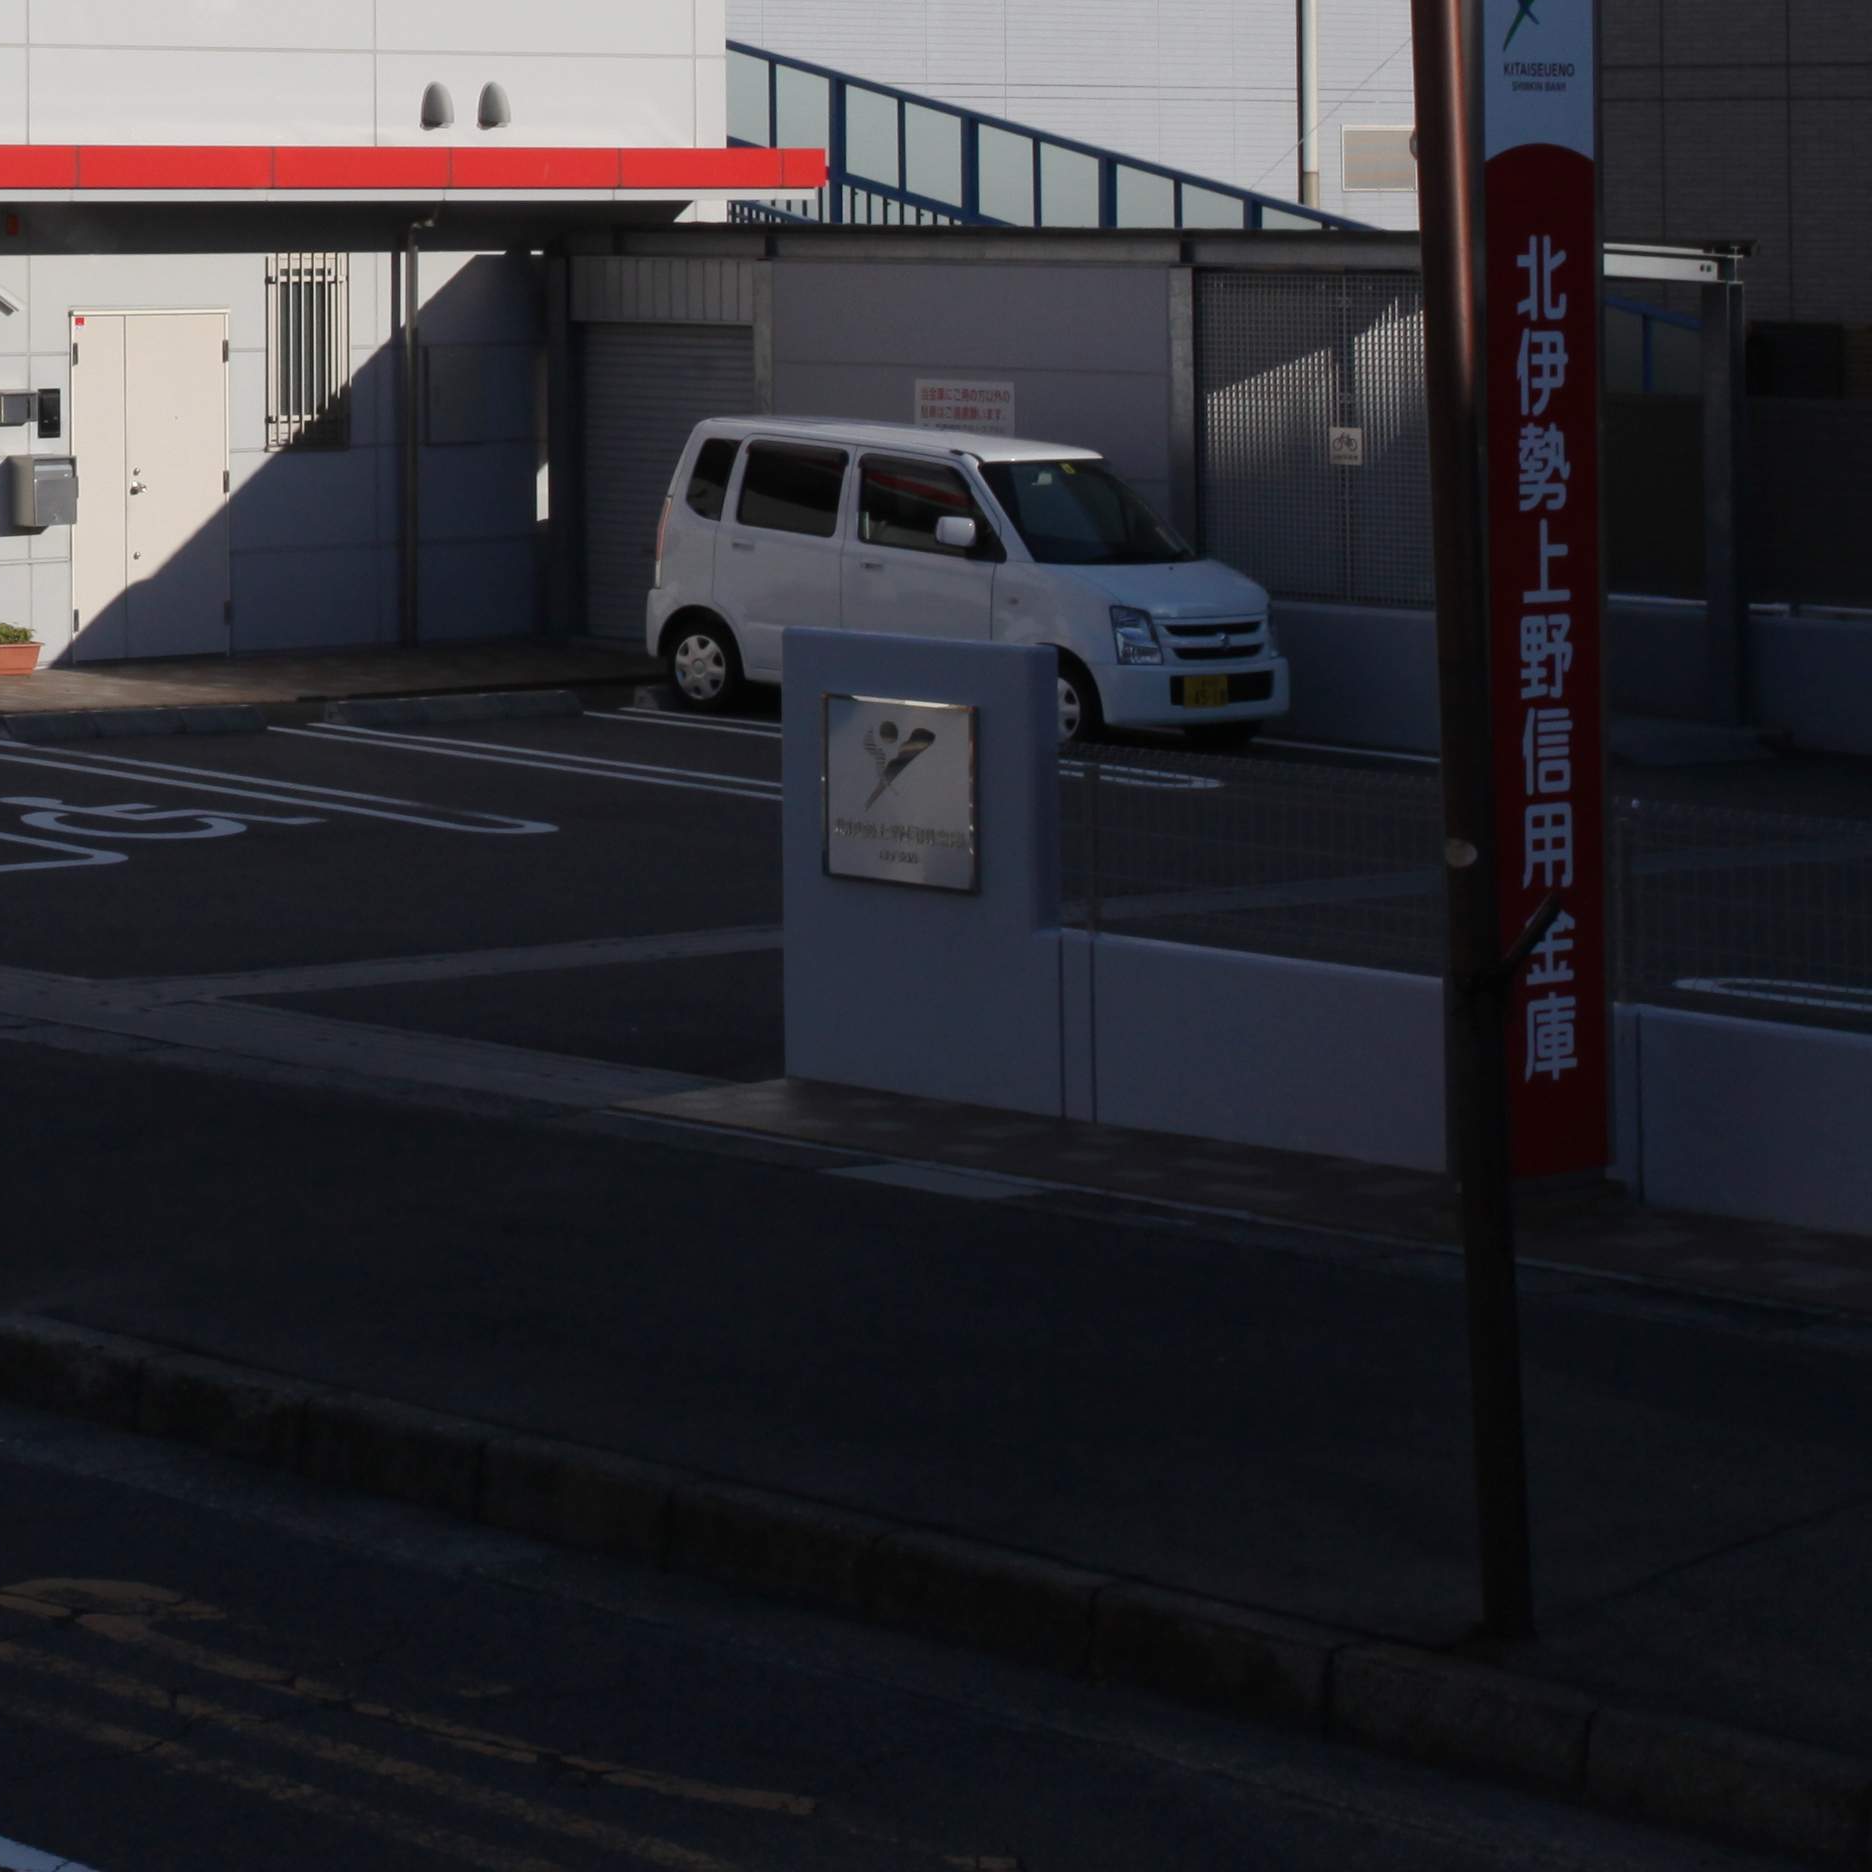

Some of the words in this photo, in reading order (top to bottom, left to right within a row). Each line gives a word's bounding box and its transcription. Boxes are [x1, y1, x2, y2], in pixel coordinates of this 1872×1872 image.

[1503, 62, 1575, 77] KITAISEUENO
[1514, 233, 1579, 1083] 北伊勢上野信用金庫
